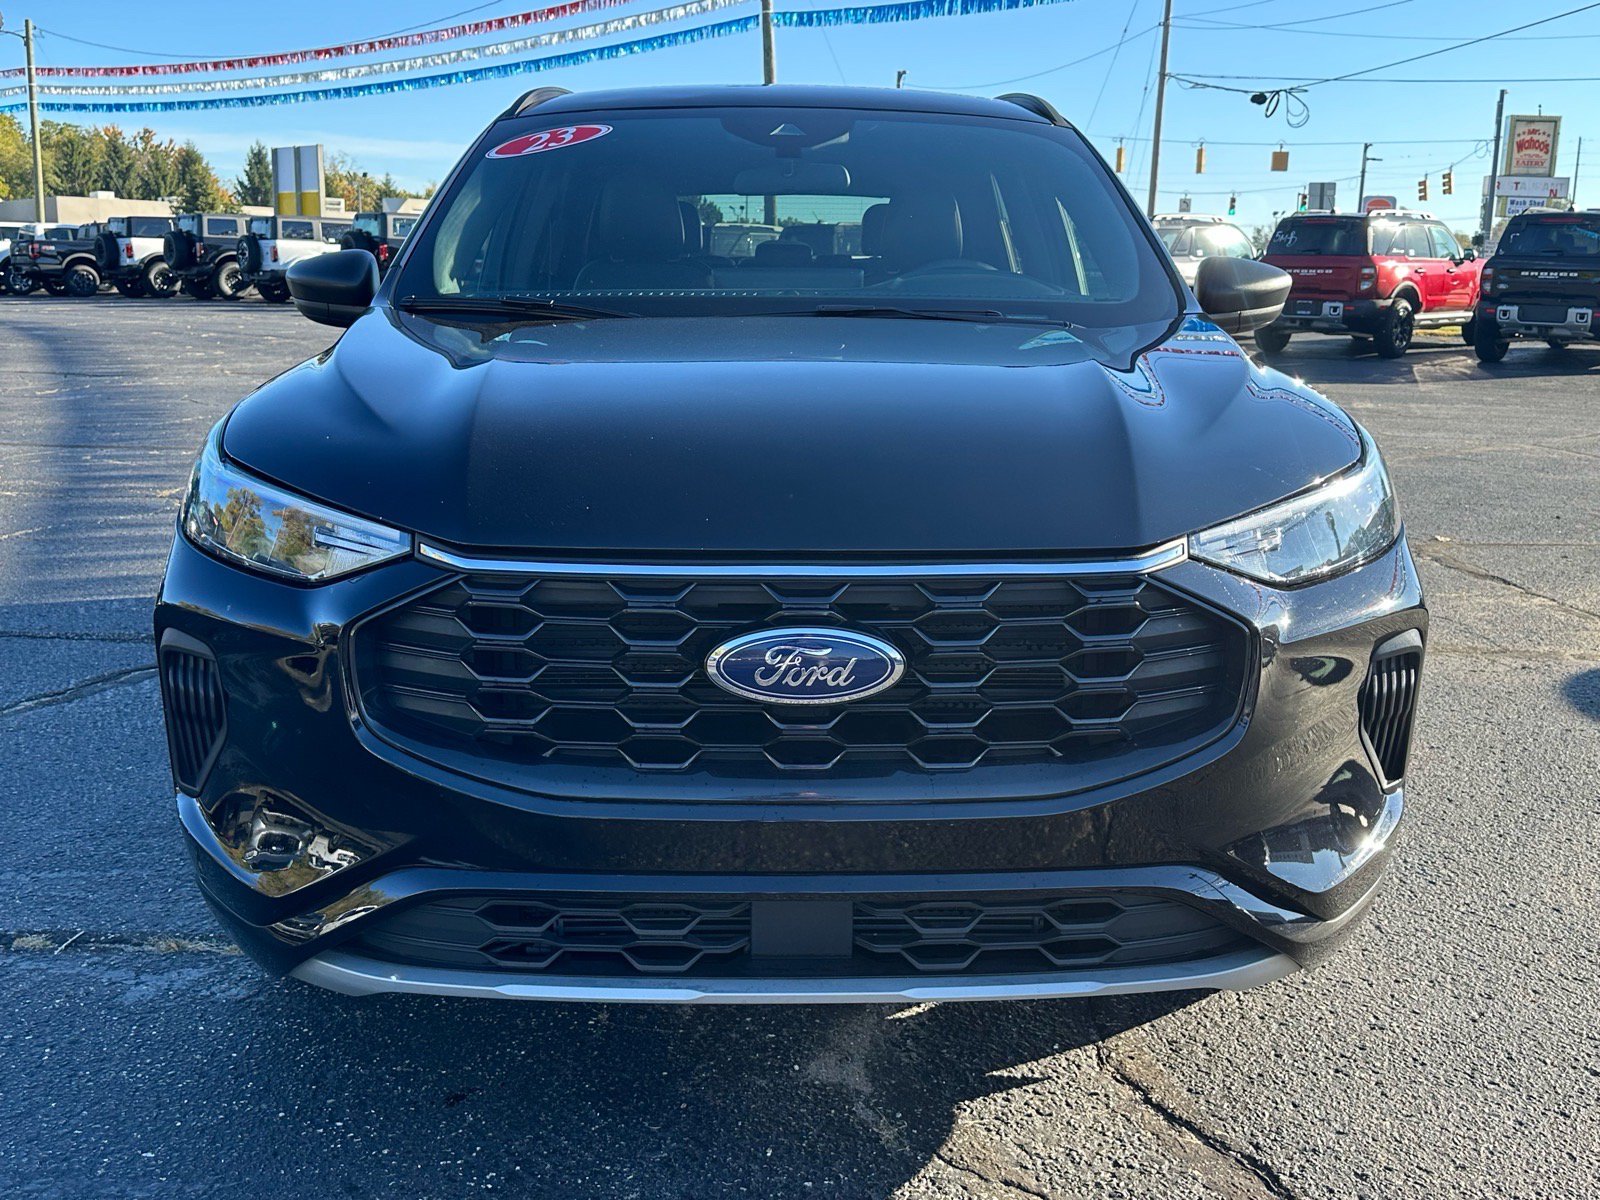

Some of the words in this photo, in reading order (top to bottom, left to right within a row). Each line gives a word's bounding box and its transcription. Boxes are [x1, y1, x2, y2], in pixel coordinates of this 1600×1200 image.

[521, 126, 577, 153] 23
[1516, 136, 1550, 155] Wahoo's
[754, 645, 858, 687] Ford
